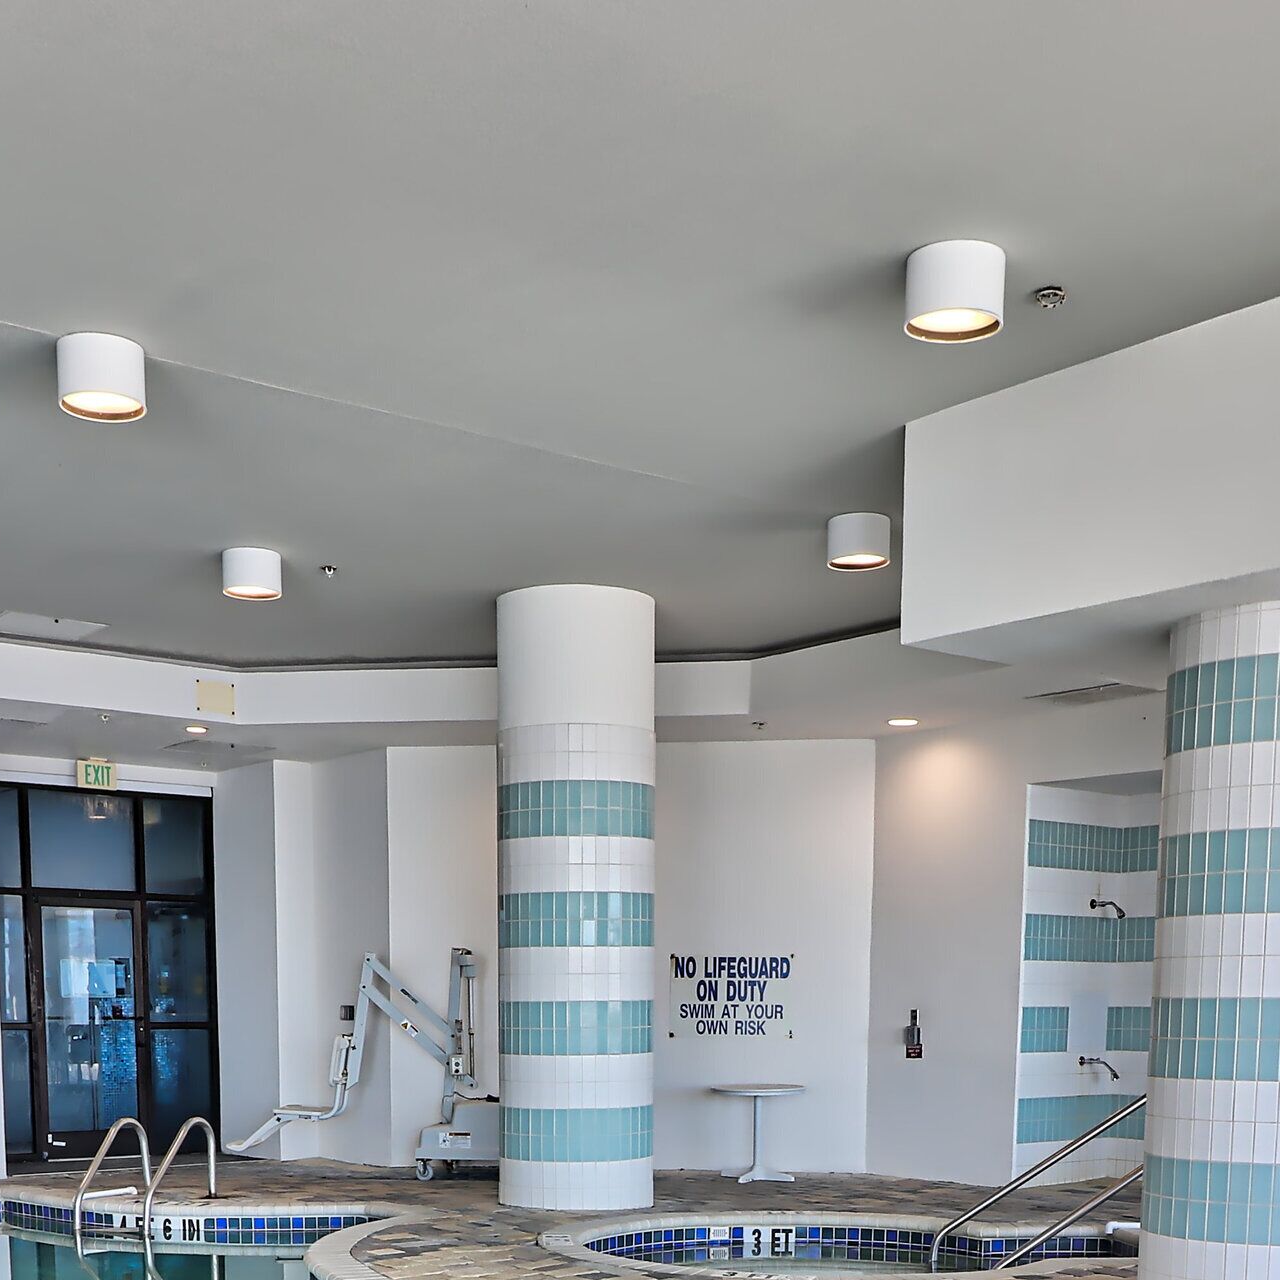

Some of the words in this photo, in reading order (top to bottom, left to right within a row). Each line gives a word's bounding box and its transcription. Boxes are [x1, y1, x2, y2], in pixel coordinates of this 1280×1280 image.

[84, 764, 111, 786] EXIT
[674, 956, 697, 979] NO
[704, 956, 791, 979] LIFEGUARD
[696, 979, 718, 1002] ON
[726, 980, 768, 1002] DUTY
[679, 1003, 715, 1019] SWIM
[721, 1004, 740, 1019] AT
[746, 1004, 784, 1020] YOUR
[696, 1020, 728, 1035] OWN
[734, 1020, 766, 1035] RISK
